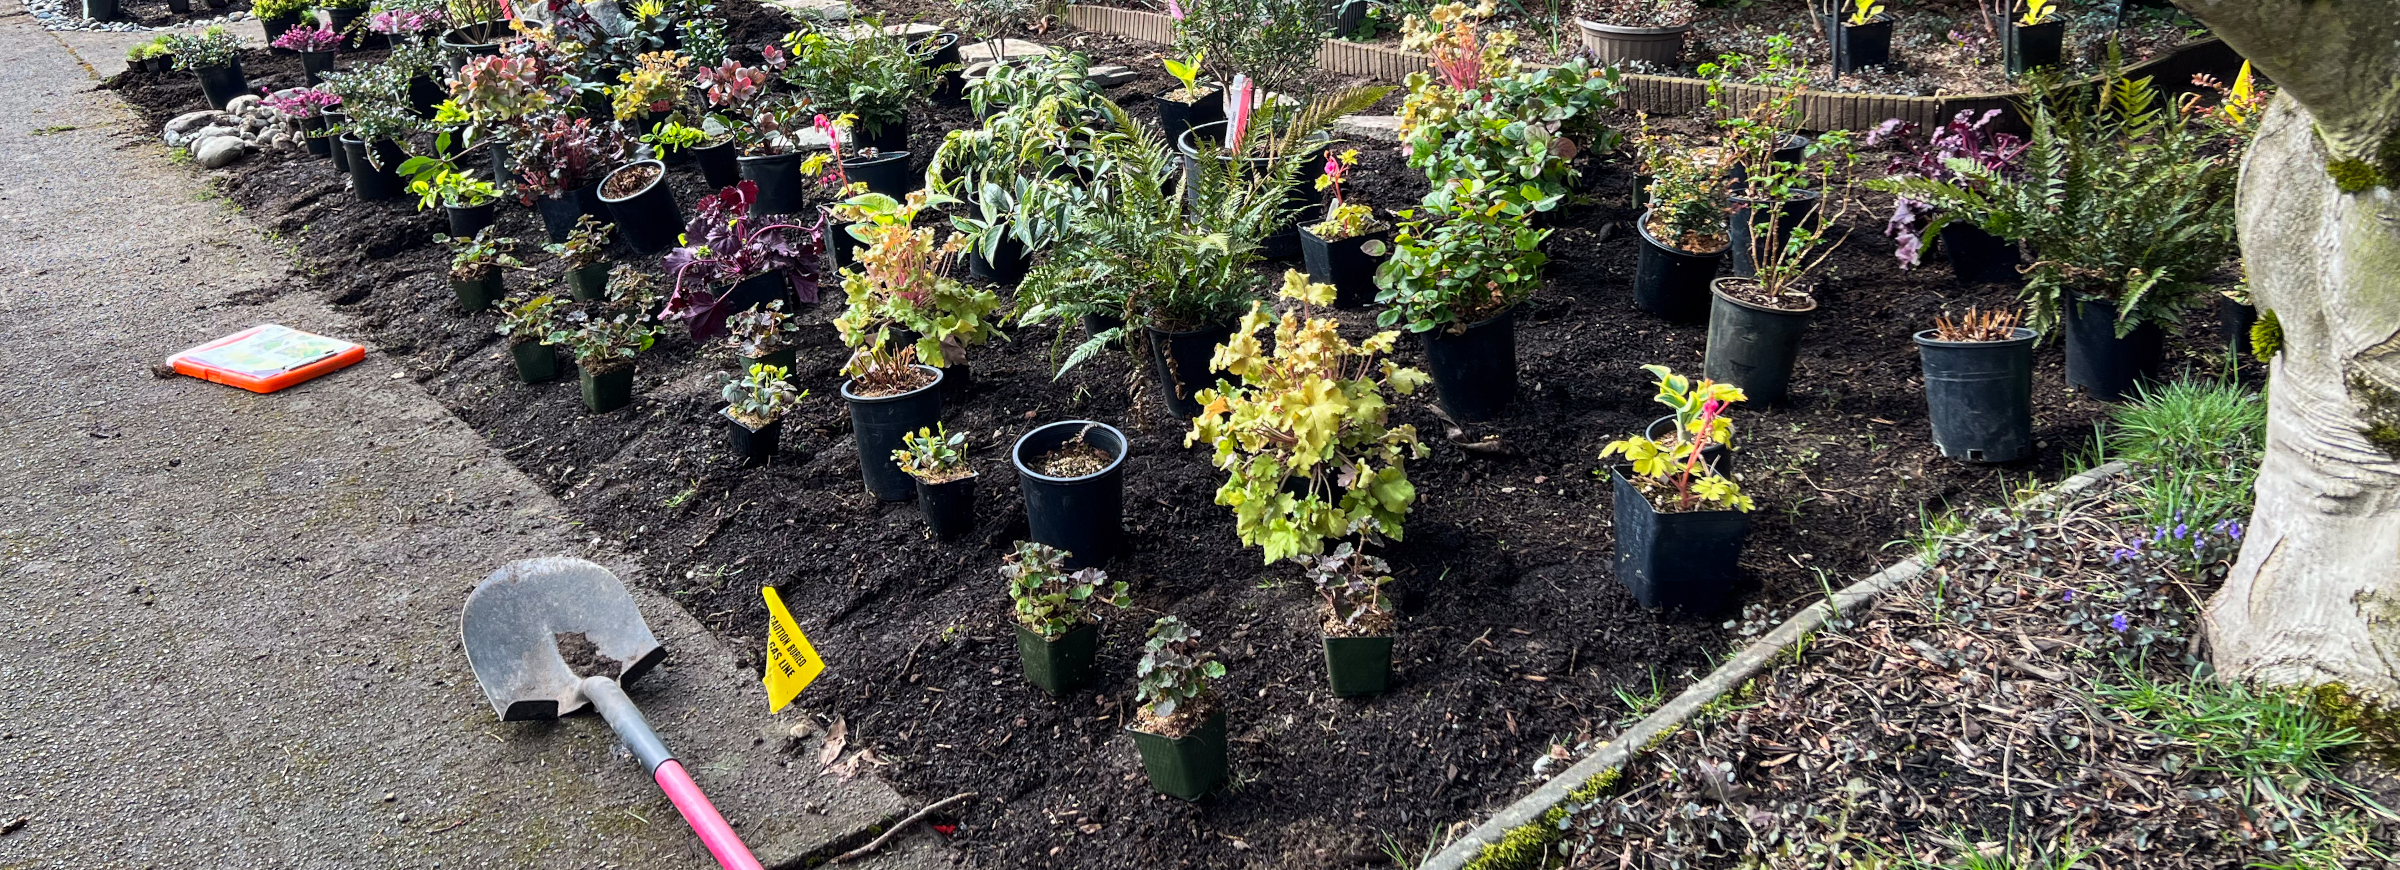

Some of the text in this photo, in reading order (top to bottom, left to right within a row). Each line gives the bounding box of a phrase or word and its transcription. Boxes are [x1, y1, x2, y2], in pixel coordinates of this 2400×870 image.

[769, 641, 795, 678] GAS LINE
[770, 615, 807, 667] CAUTION BURIED
